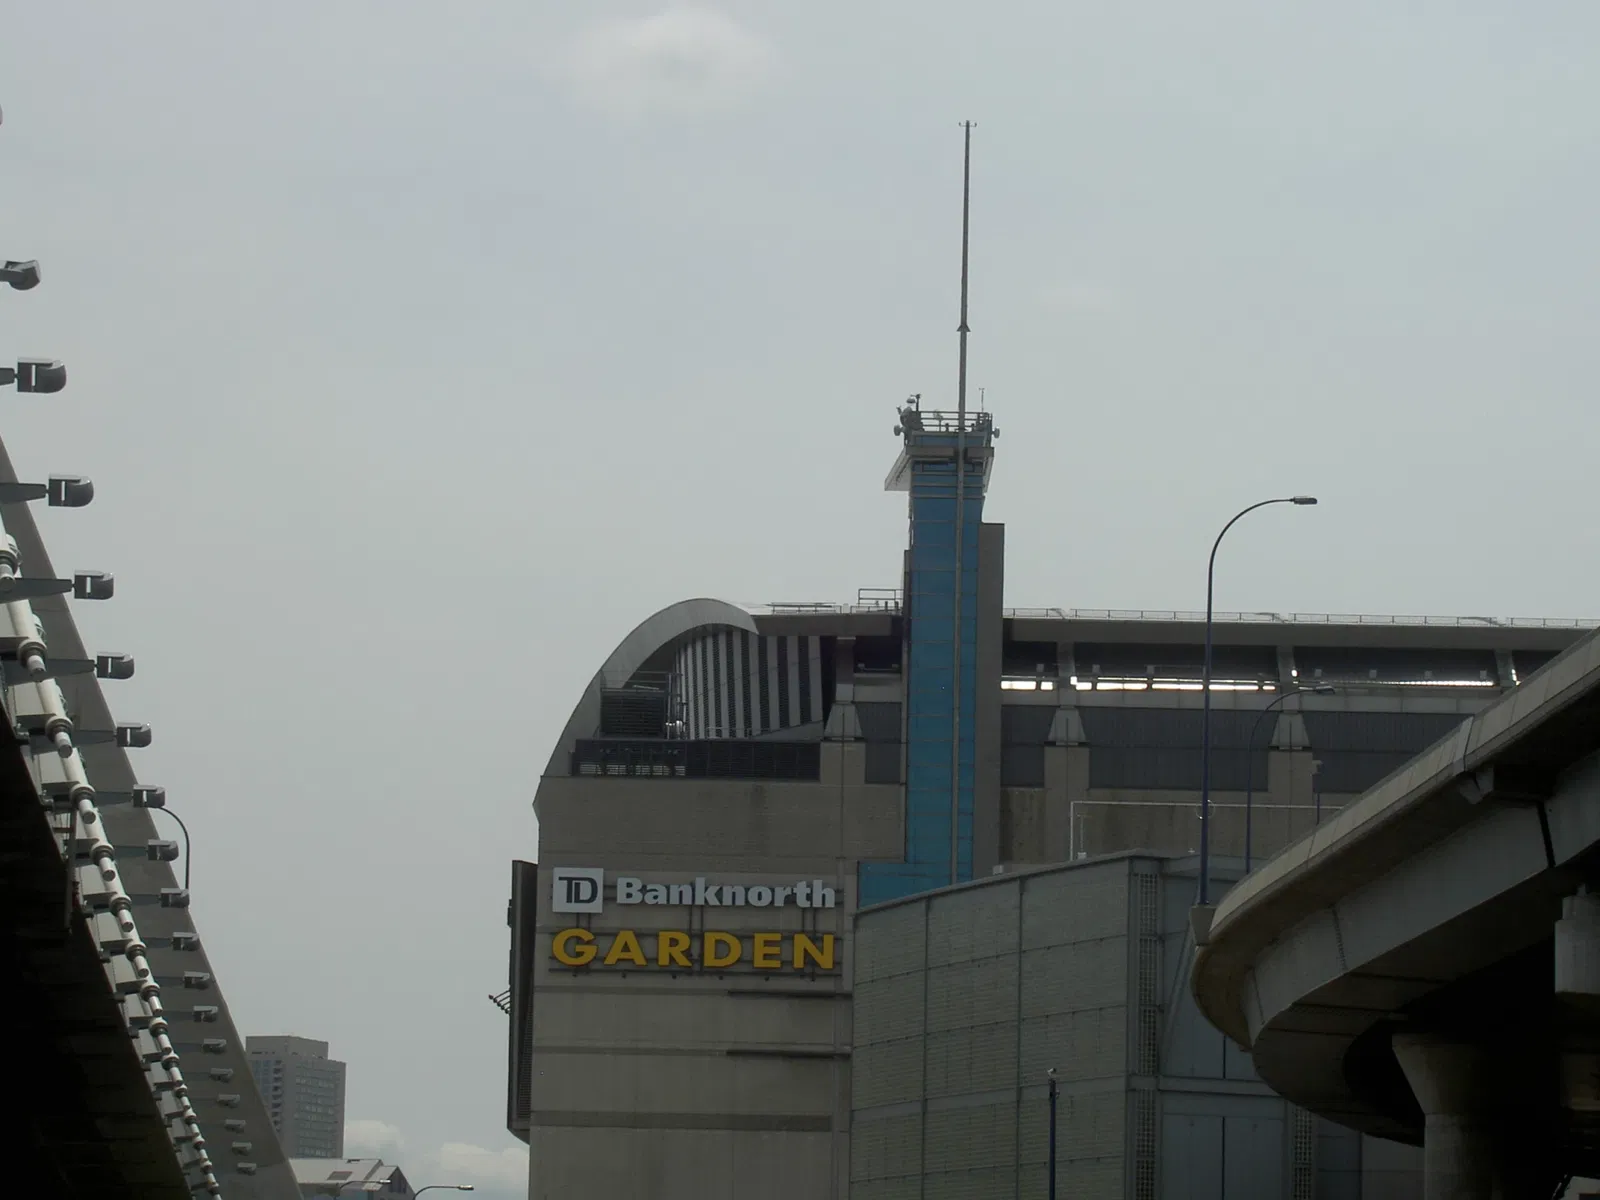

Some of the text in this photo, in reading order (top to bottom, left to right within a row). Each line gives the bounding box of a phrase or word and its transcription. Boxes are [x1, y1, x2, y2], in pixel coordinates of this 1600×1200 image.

[558, 876, 836, 908] TD Banknorth
[552, 928, 835, 969] GARDEN
